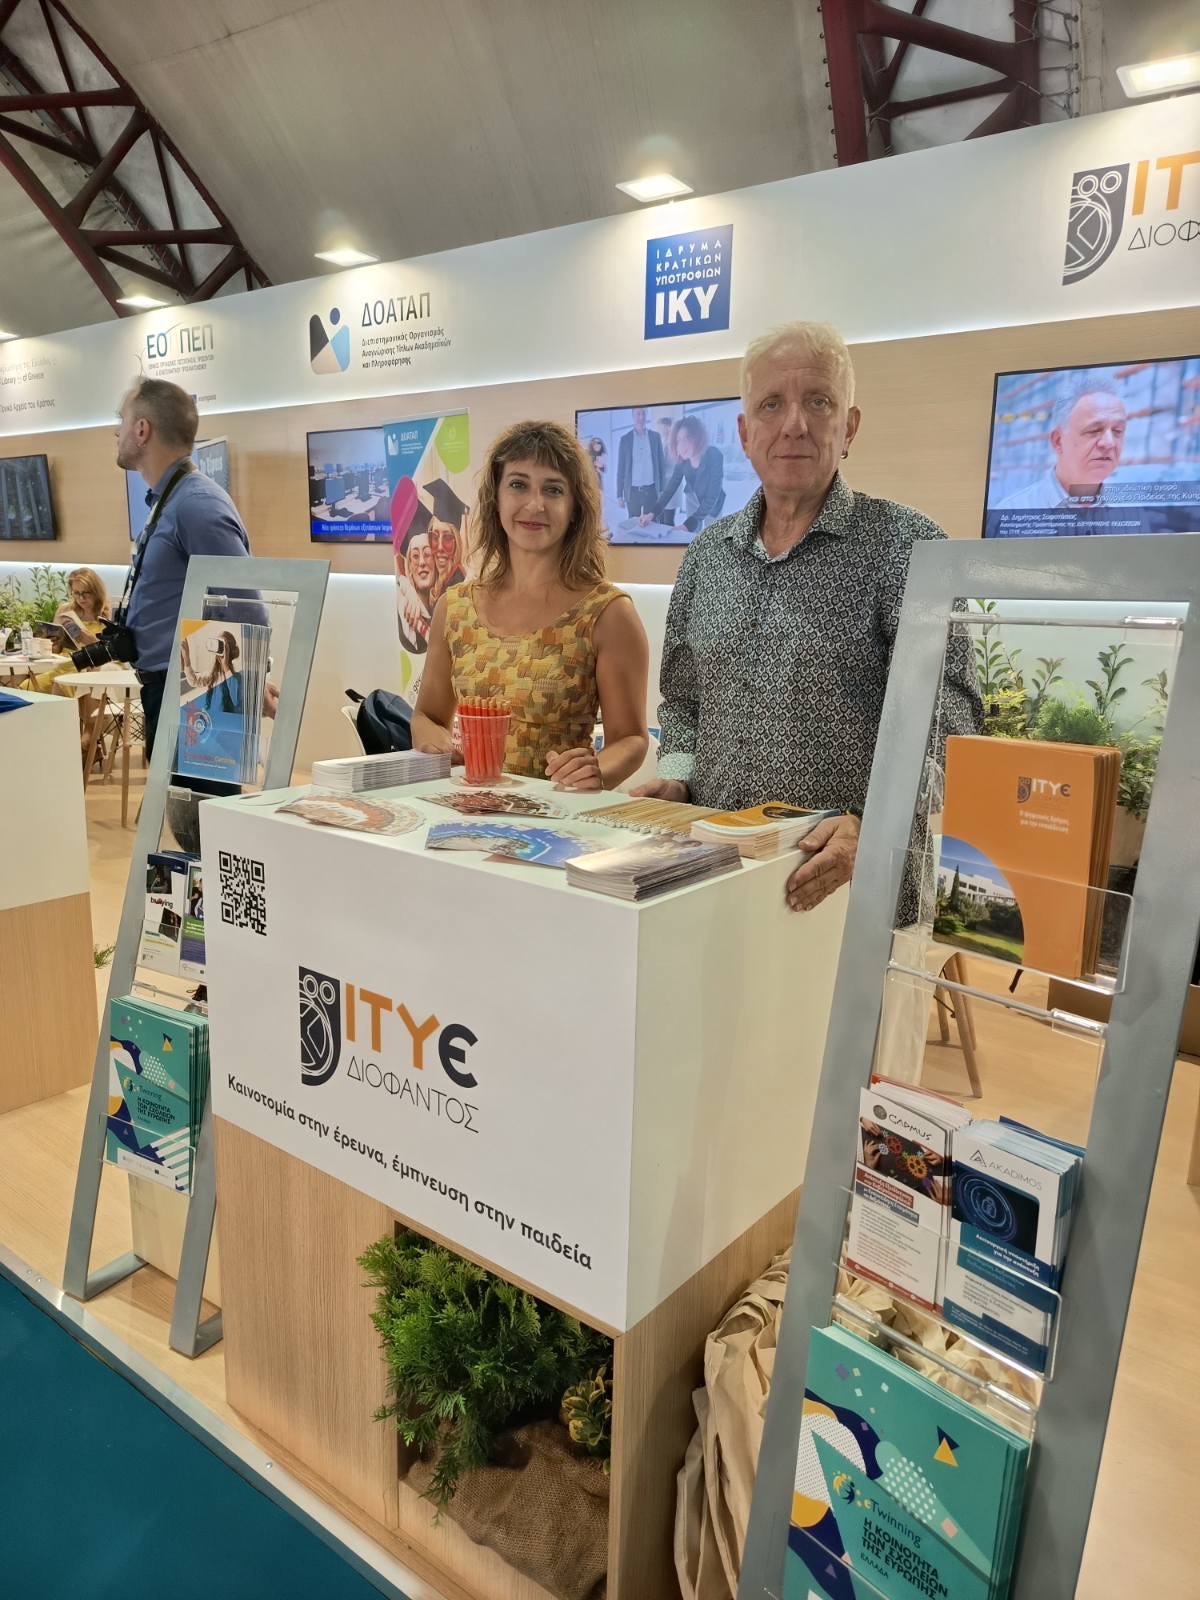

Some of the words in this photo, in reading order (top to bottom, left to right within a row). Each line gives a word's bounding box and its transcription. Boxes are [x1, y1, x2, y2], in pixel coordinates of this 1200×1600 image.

[656, 239, 722, 259] ΙΔΡΥΜΑ
[1128, 219, 1200, 251] ΔΙΟΦ
[655, 266, 722, 286] ΥΠΟΤΡΟΦΙΩΝ
[656, 252, 722, 273] ΚΡΑΤΙΚΩΝ
[362, 292, 431, 328] ΔΟΑΤΑΠ
[655, 284, 719, 326] ΙΚΥ
[150, 896, 174, 910] bullying
[346, 1055, 479, 1133] ΔΙΟΦΑΝΤΟΣ
[228, 1073, 295, 1120] Καινοτομία
[298, 1113, 330, 1138] στην
[333, 1126, 387, 1168] έρευνα,
[392, 1154, 469, 1212] έμπνευση
[474, 1200, 515, 1230] στην
[521, 1222, 592, 1270] παιδεία
[988, 1161, 1042, 1191] AKADIMOS
[863, 1498, 922, 1549] eTwinning
[860, 1552, 889, 1579] ΕΛΛΑΔΑ
[863, 1526, 886, 1551] ΤΩΝ
[888, 1546, 949, 1598] ΣΧΟΛΕΙΩΝ
[864, 1516, 873, 1531] Η
[875, 1525, 939, 1580] ΚΟΙΝΟΤΗΤΑ
[861, 1536, 882, 1560] ΤΗΣ
[884, 1555, 937, 1600] ΕΥΡΩΠΗΣ
